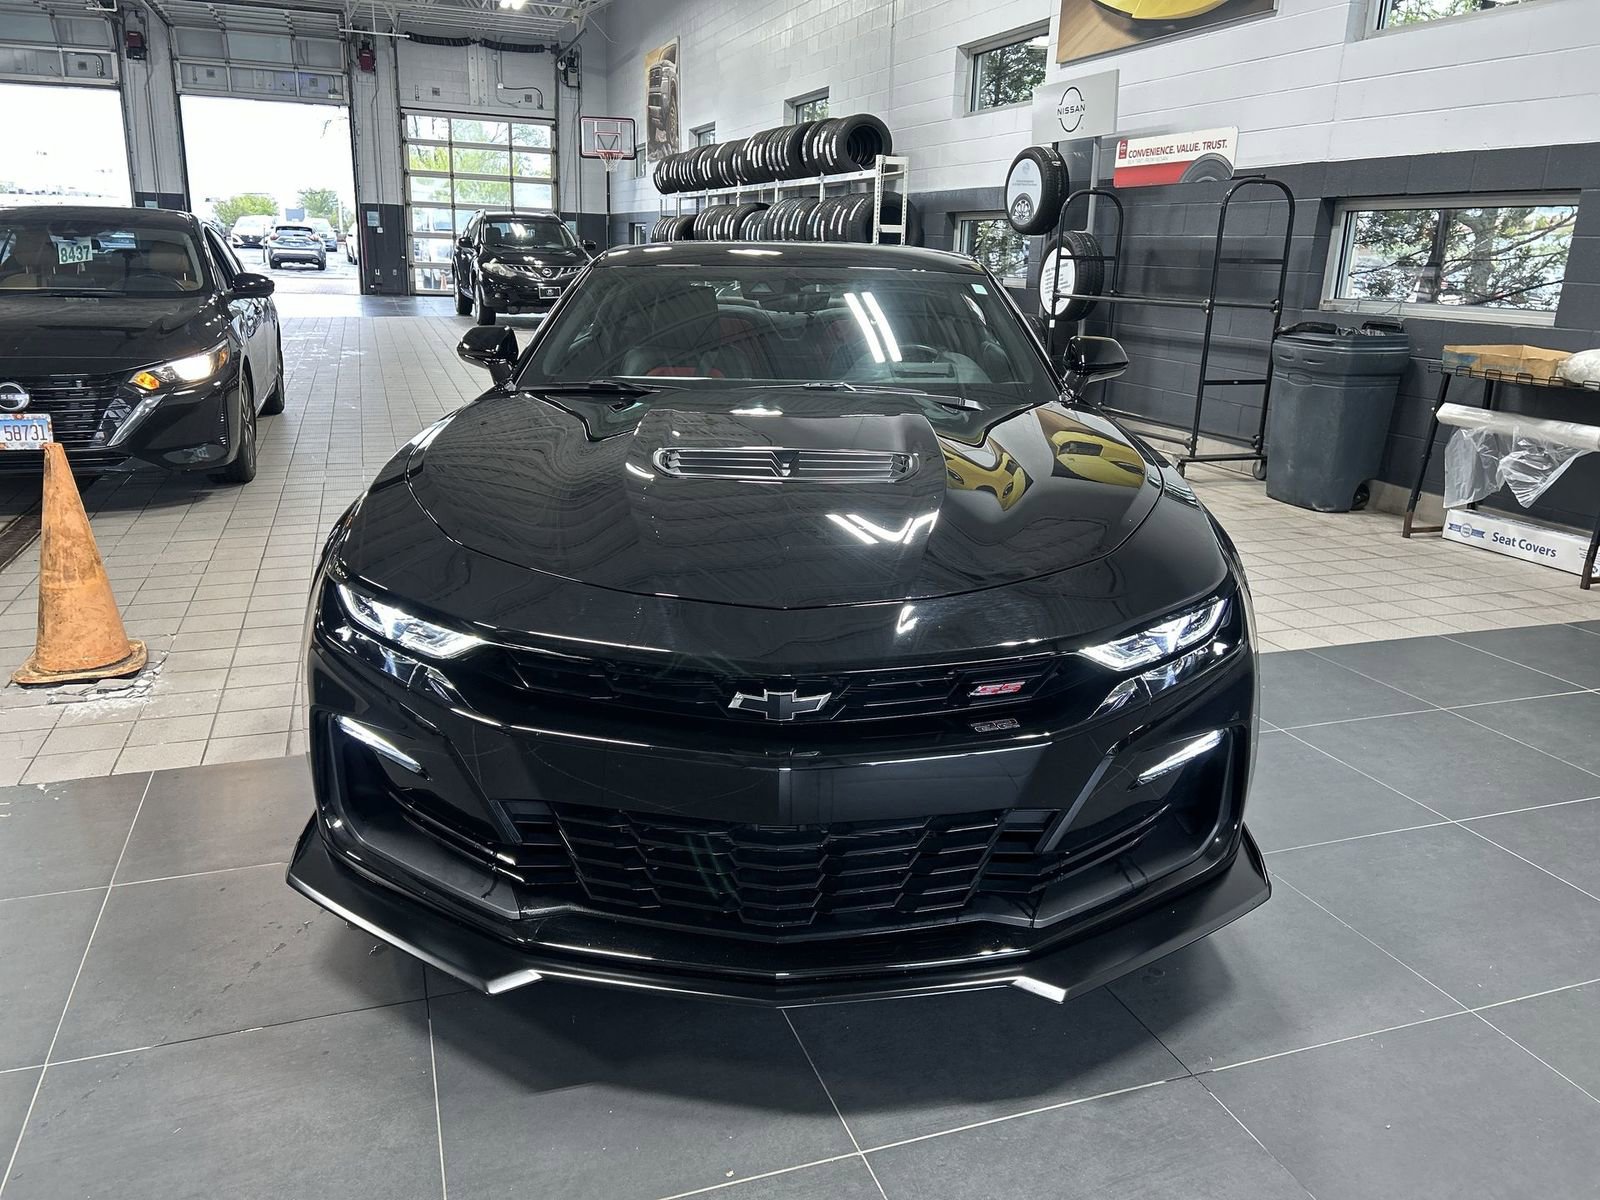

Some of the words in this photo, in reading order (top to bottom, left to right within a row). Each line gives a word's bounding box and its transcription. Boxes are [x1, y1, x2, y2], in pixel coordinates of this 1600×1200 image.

[1057, 104, 1085, 116] NISSAN
[1128, 145, 1175, 159] CONVENIENCE.
[1176, 142, 1200, 153] VALUE.
[1202, 139, 1228, 150] TRUST.
[60, 244, 90, 263] 8437
[3, 424, 48, 441] 58731
[1492, 532, 1516, 548] Seat
[1518, 539, 1557, 558] Covers
